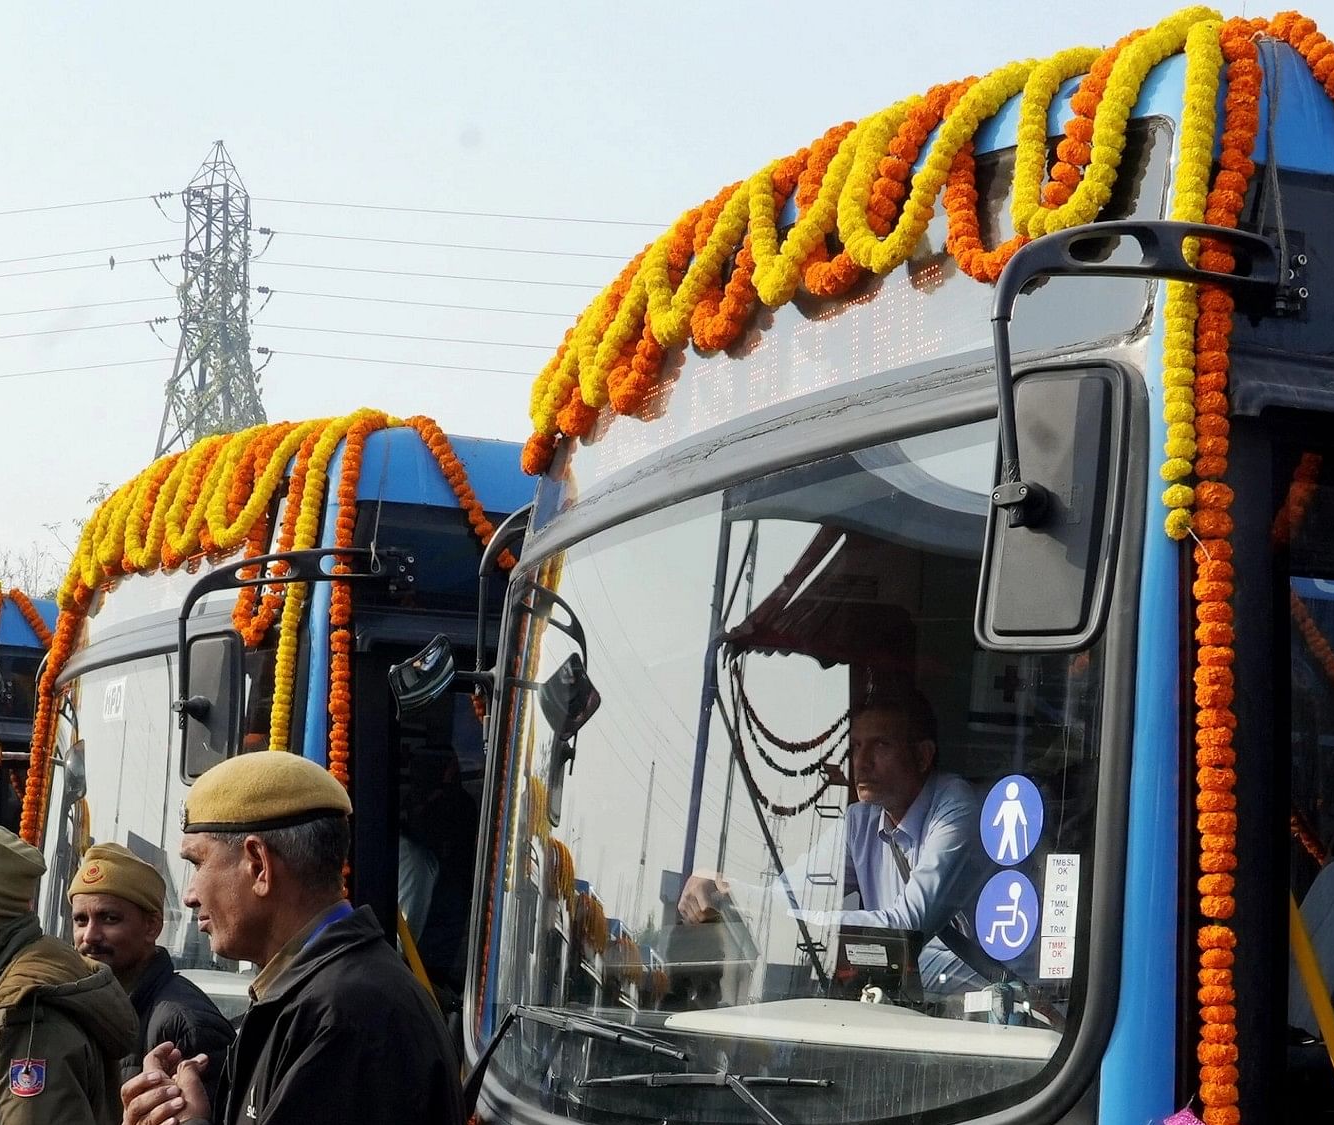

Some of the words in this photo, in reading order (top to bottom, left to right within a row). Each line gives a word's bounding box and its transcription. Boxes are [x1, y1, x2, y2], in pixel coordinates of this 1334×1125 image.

[1057, 867, 1068, 875] OK
[1054, 909, 1065, 917] OK
[1051, 950, 1063, 958] OK
[1048, 967, 1065, 975] TEST
